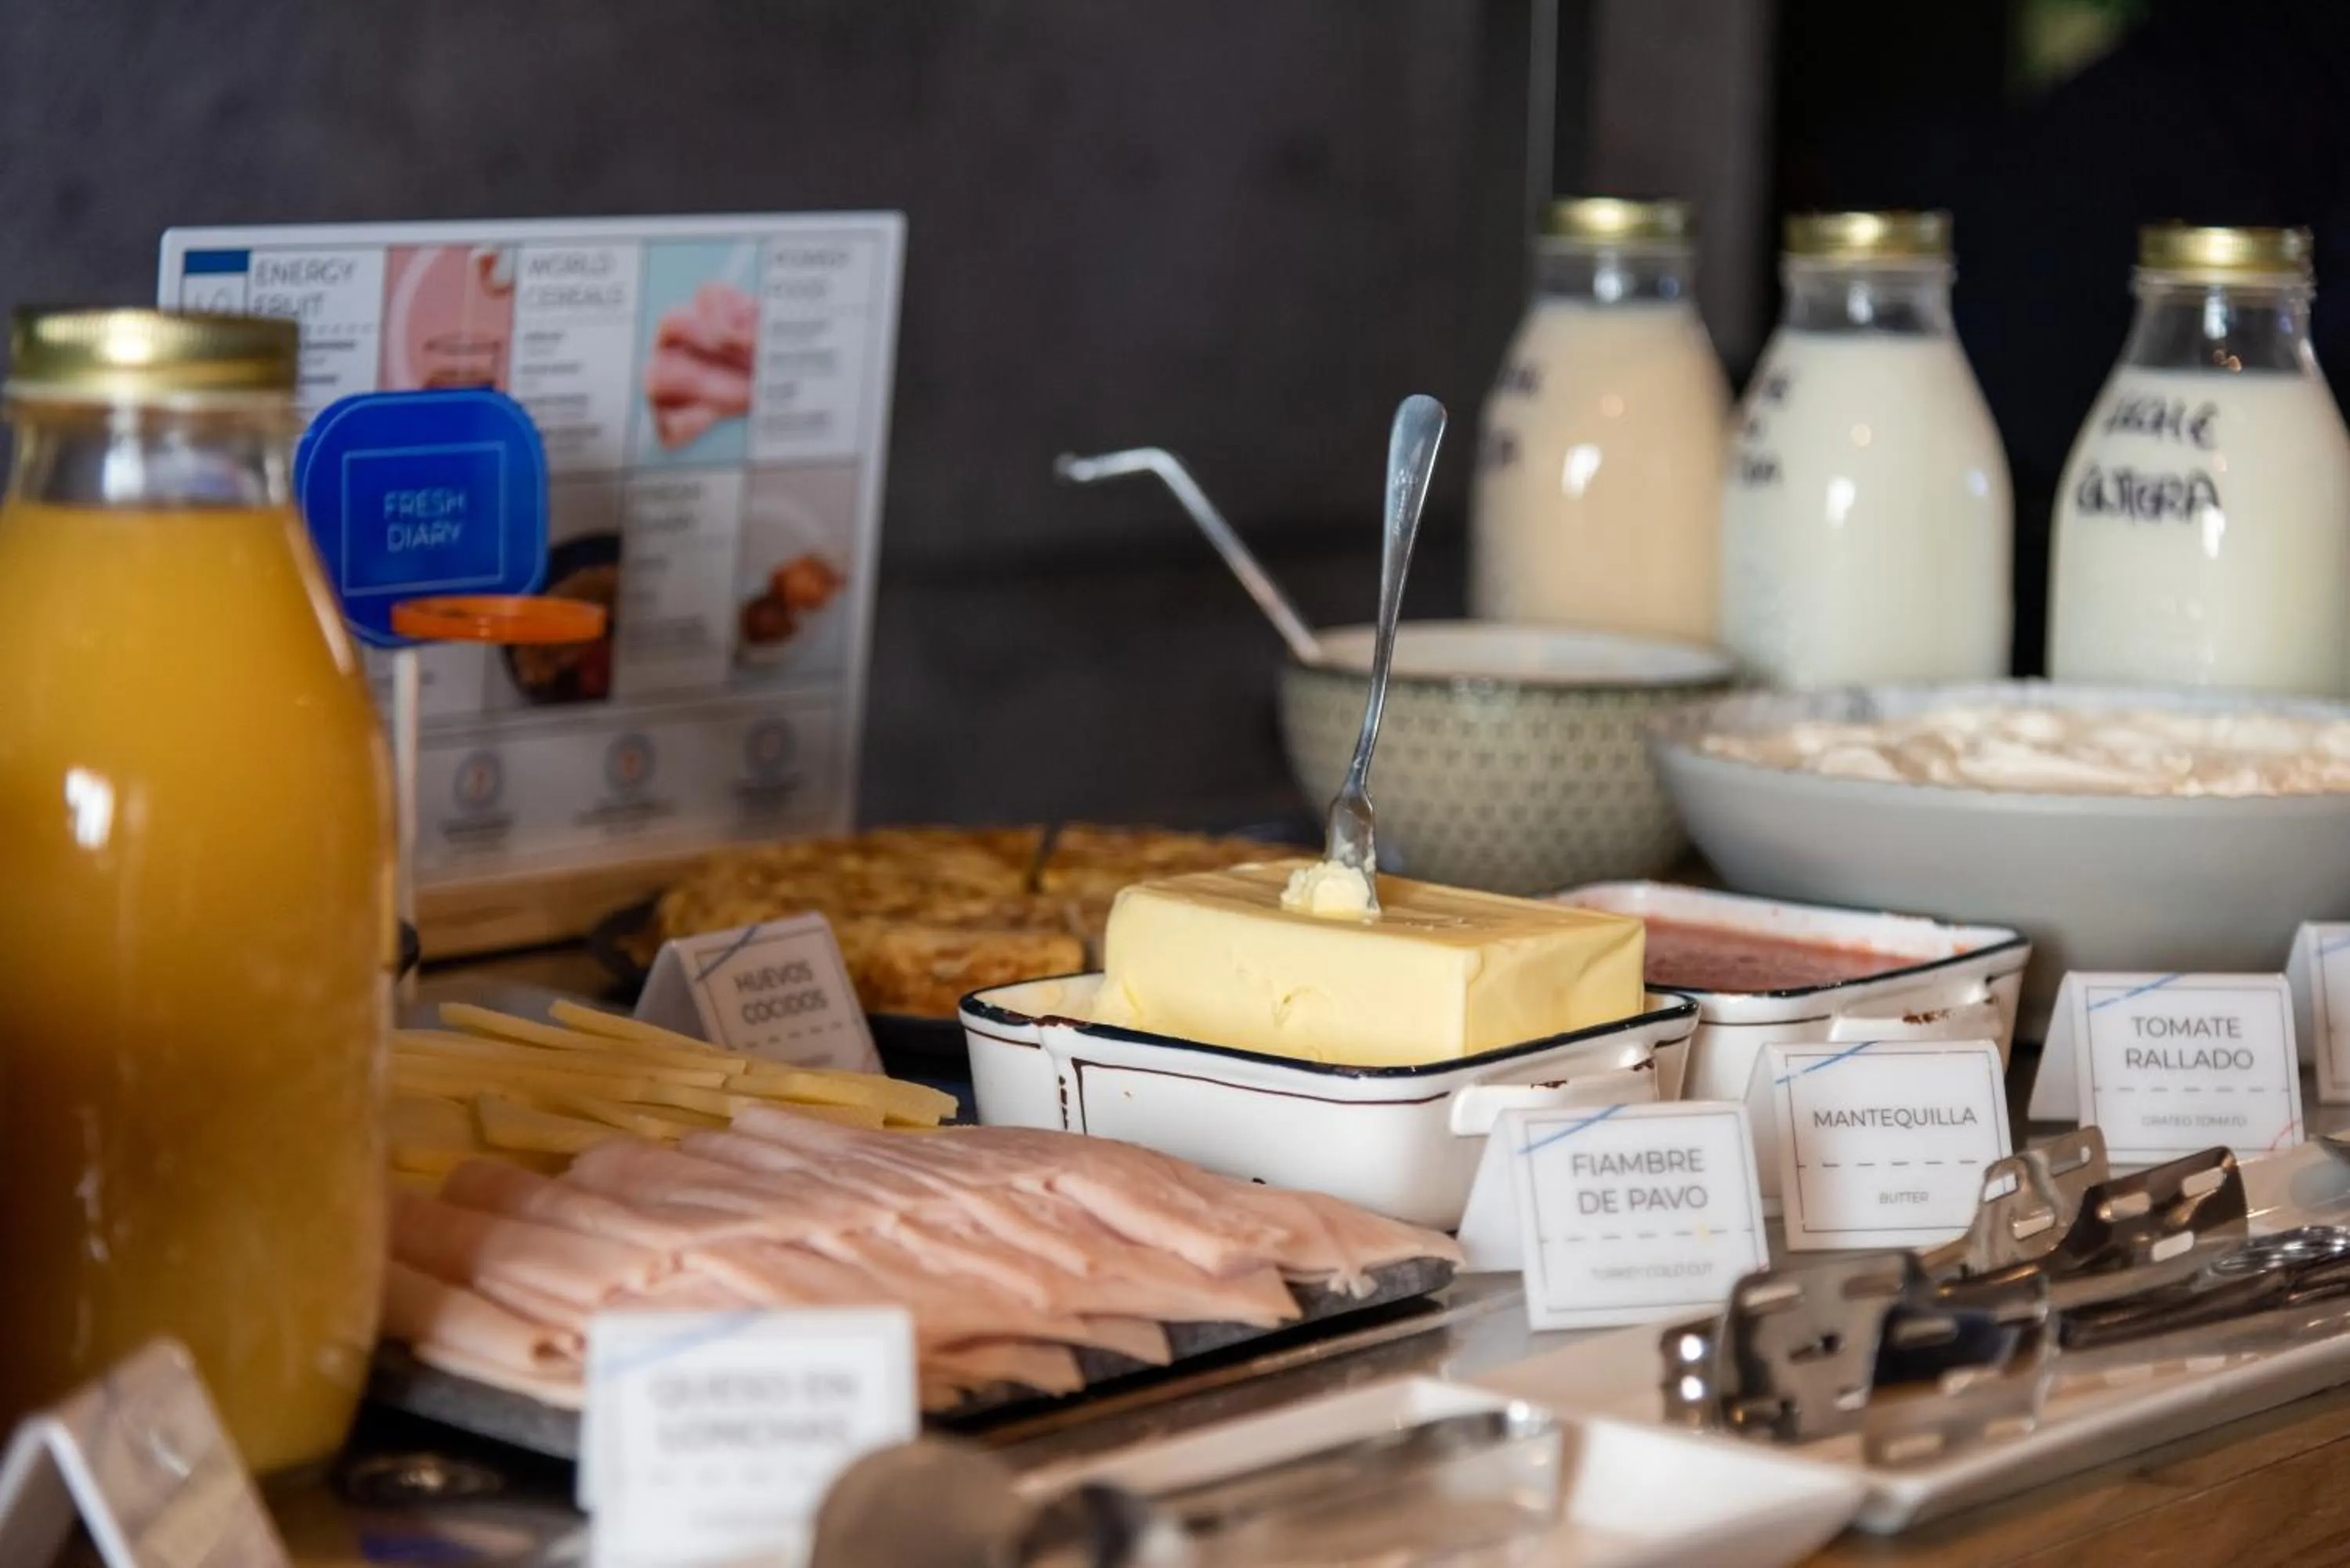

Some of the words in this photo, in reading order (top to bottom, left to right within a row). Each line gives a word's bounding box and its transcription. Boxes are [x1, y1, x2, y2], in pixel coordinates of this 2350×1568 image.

[255, 257, 358, 287] ENERGY
[383, 487, 465, 518] FRESH
[387, 521, 462, 551] DIARY
[733, 959, 813, 993] HUEVOS
[741, 988, 829, 1025] COCIDOS
[2131, 1016, 2243, 1039] TOMATE
[2125, 1047, 2254, 1071] RALLADO
[1813, 1106, 1978, 1129] MANTEQUILLA
[1571, 1148, 1706, 1178] FIAMBRE
[1578, 1188, 1622, 1216] DE
[1630, 1184, 1708, 1213] PAVO
[1878, 1190, 1929, 1205] BUTTER
